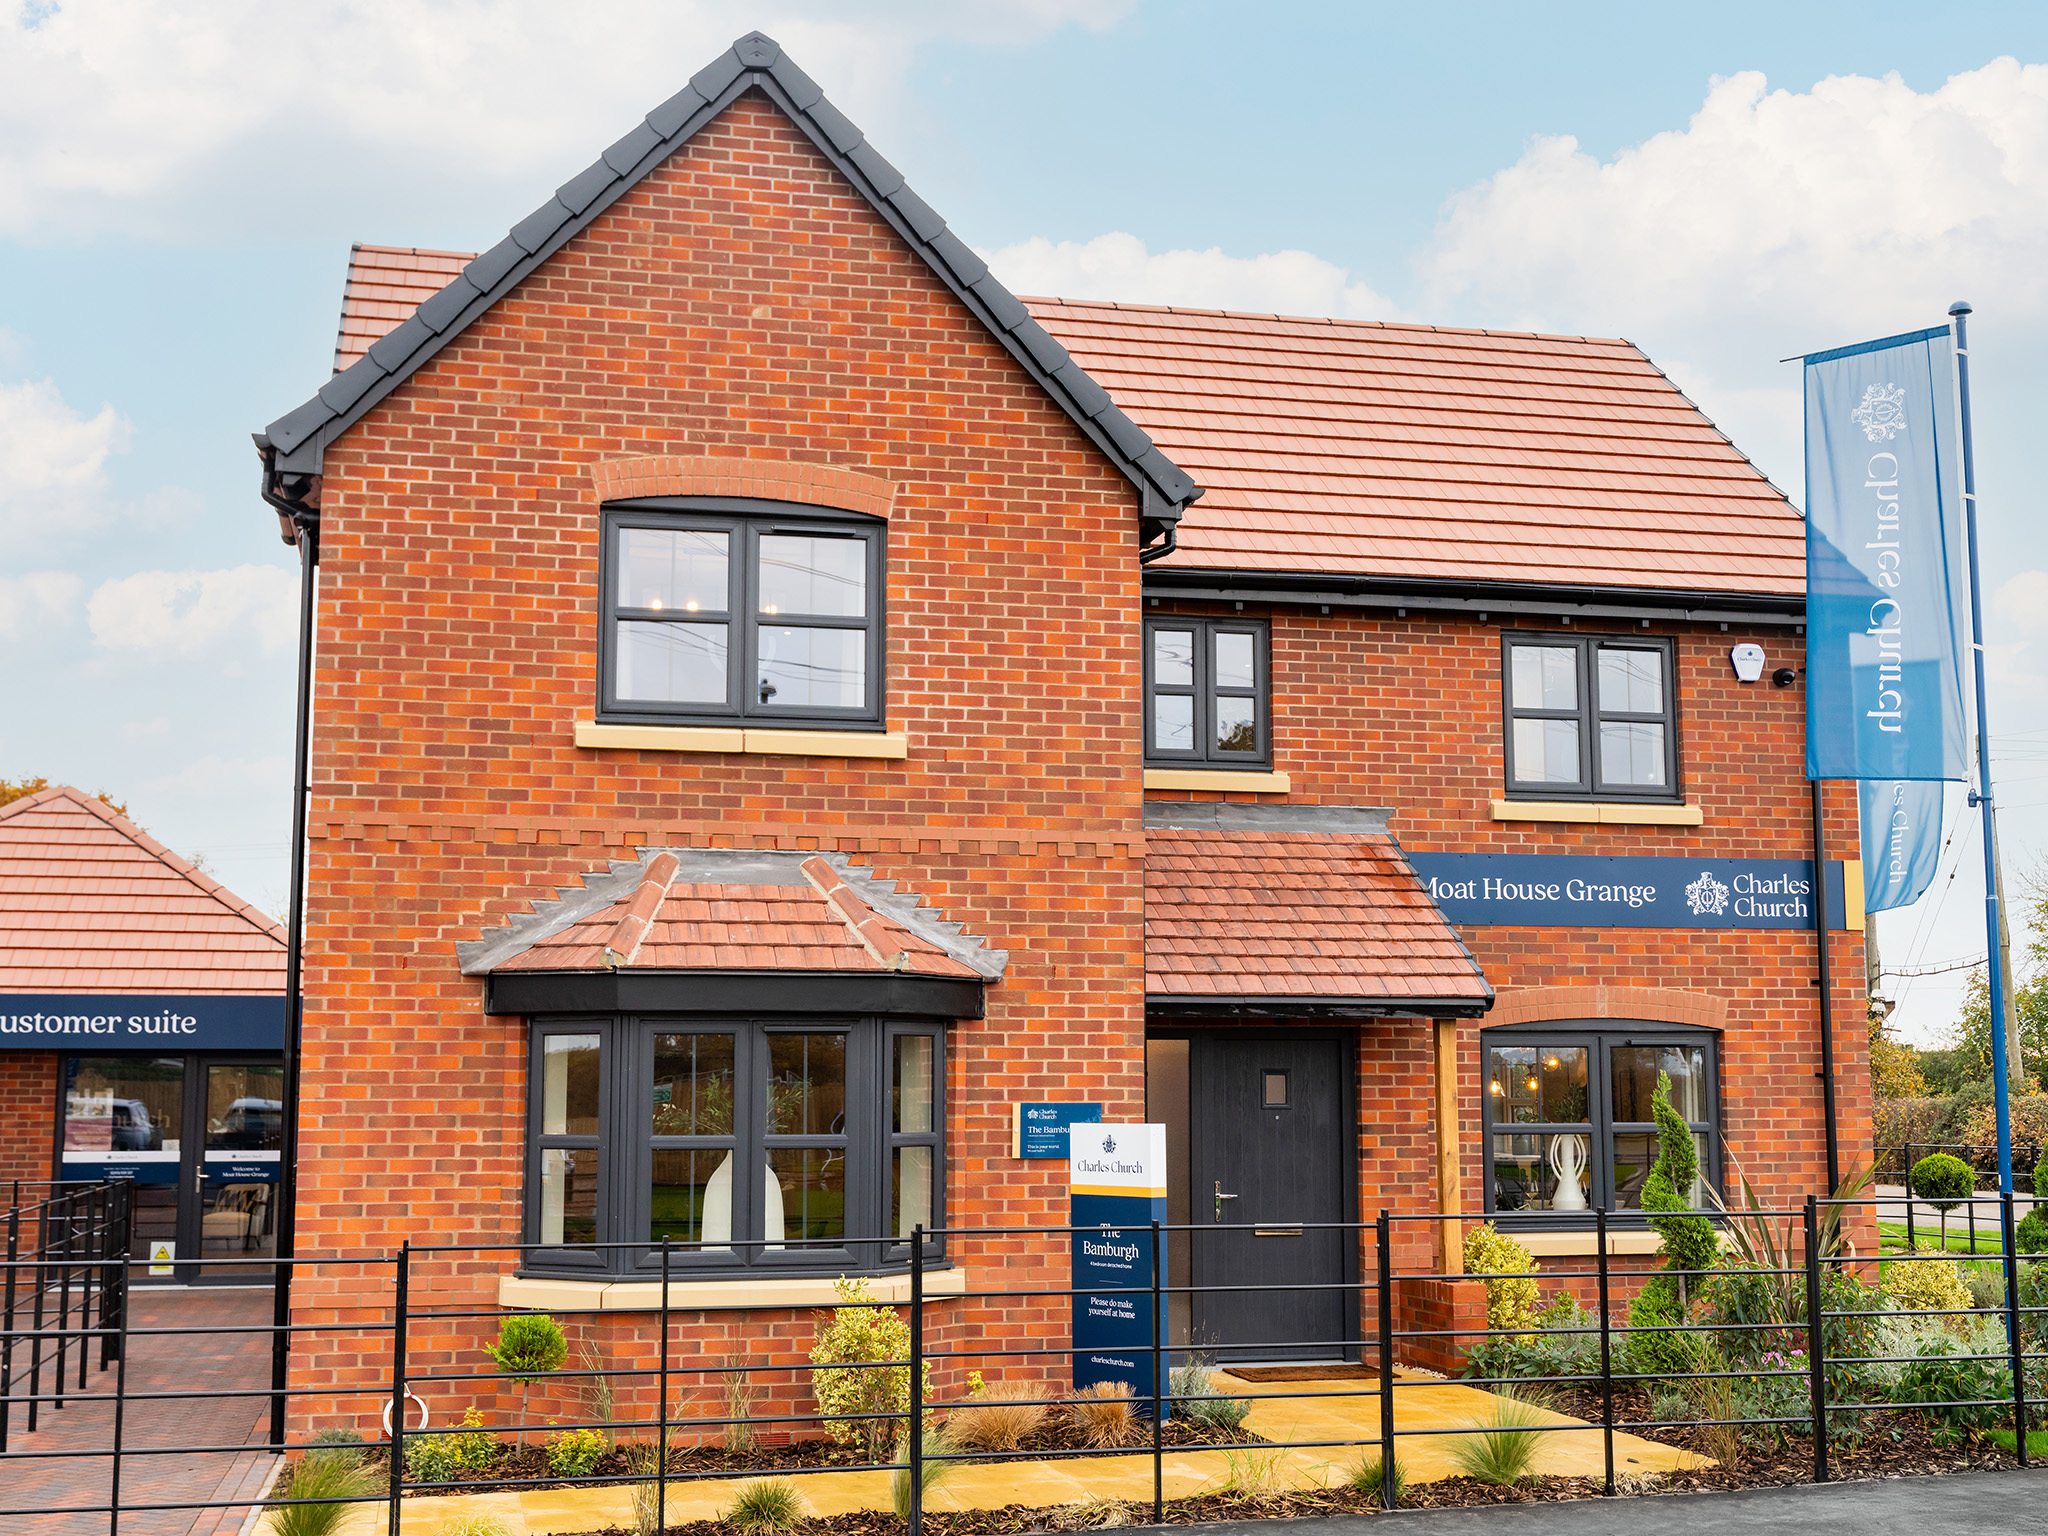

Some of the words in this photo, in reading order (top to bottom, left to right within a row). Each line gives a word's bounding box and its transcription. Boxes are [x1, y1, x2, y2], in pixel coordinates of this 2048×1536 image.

[1889, 810, 1909, 884] Church
[1482, 877, 1561, 900] House
[1566, 879, 1657, 908] Grange
[1733, 873, 1810, 895] Charles
[1734, 896, 1808, 918] Church
[0, 1012, 123, 1034] ustomer
[127, 1009, 197, 1034] suite
[1027, 1126, 1043, 1134] The
[1043, 1126, 1070, 1134] Bambu
[1078, 1159, 1110, 1173] Charles
[1110, 1160, 1143, 1174] Church
[1099, 1223, 1121, 1238] The
[1083, 1240, 1140, 1261] Bamburgh
[1090, 1297, 1108, 1307] Please
[1108, 1298, 1117, 1307] do
[1117, 1300, 1133, 1309] make
[1088, 1307, 1112, 1316] yourself
[1118, 1309, 1136, 1319] home
[1090, 1355, 1135, 1368] charleschurch.com
